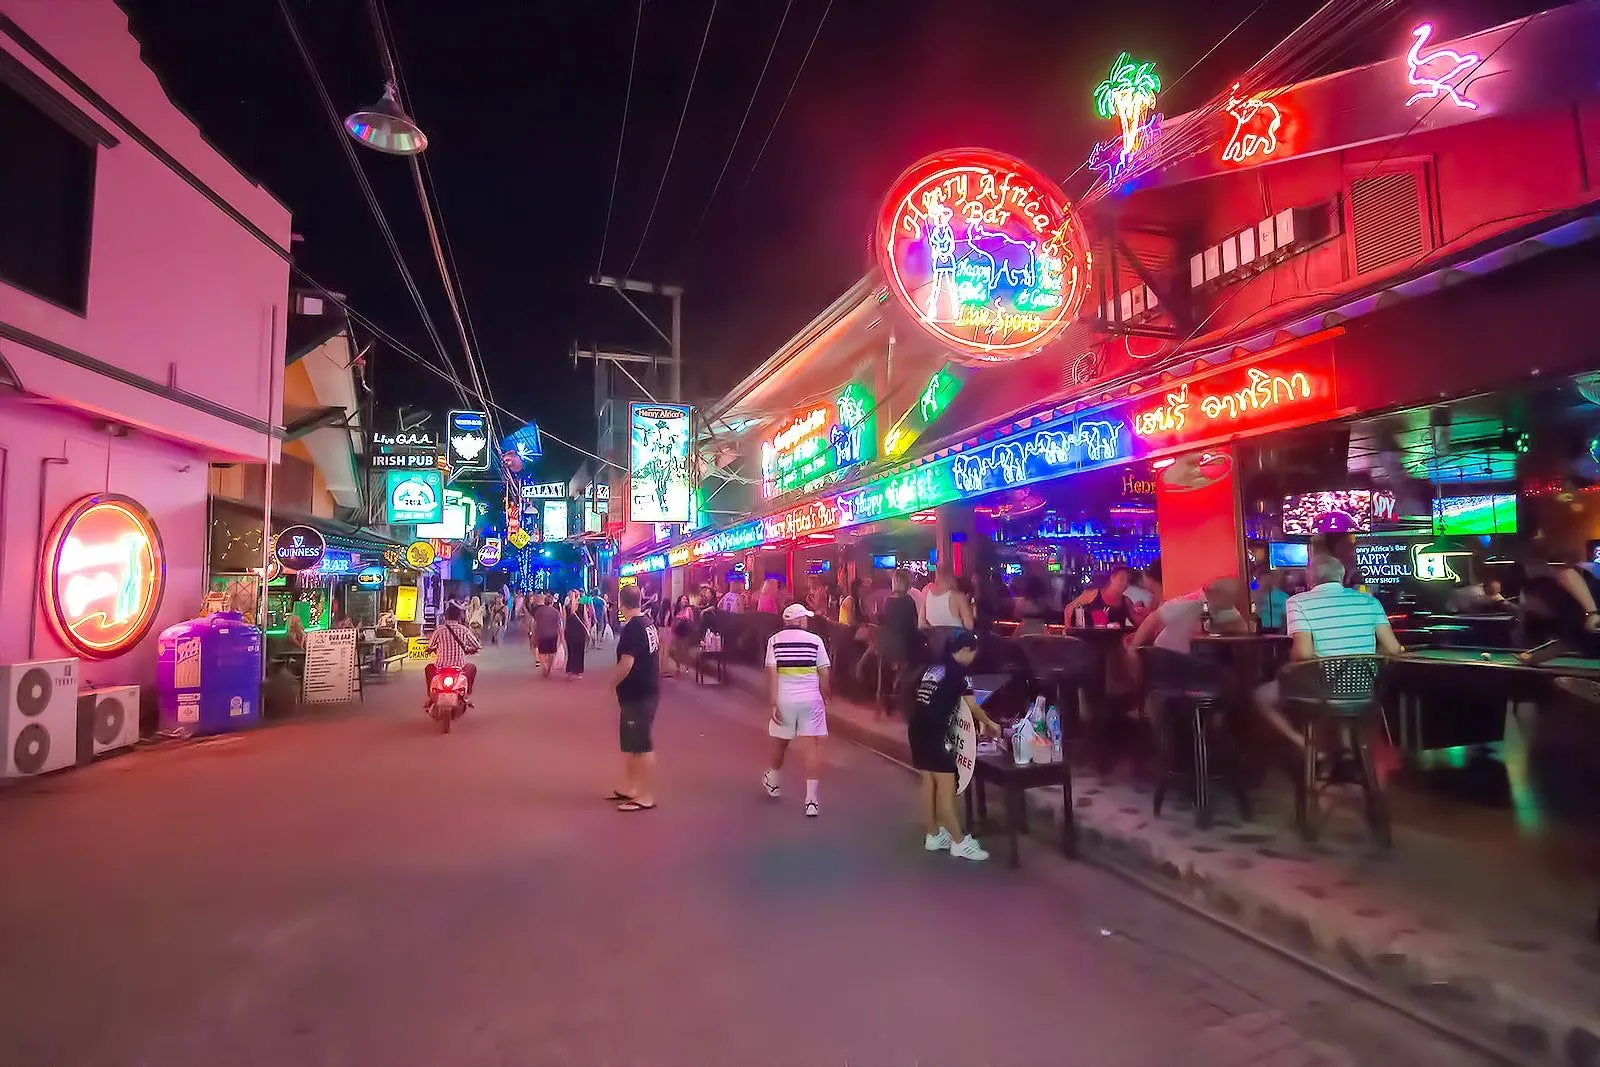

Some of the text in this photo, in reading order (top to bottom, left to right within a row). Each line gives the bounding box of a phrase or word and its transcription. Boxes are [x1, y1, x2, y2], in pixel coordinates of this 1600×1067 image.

[372, 455, 434, 467] IRISH PUB
[277, 547, 320, 557] GUINNESS
[321, 558, 350, 571] BAR
[1358, 564, 1412, 577] OWGIRL
[1364, 576, 1400, 584] SEXY SHOTS
